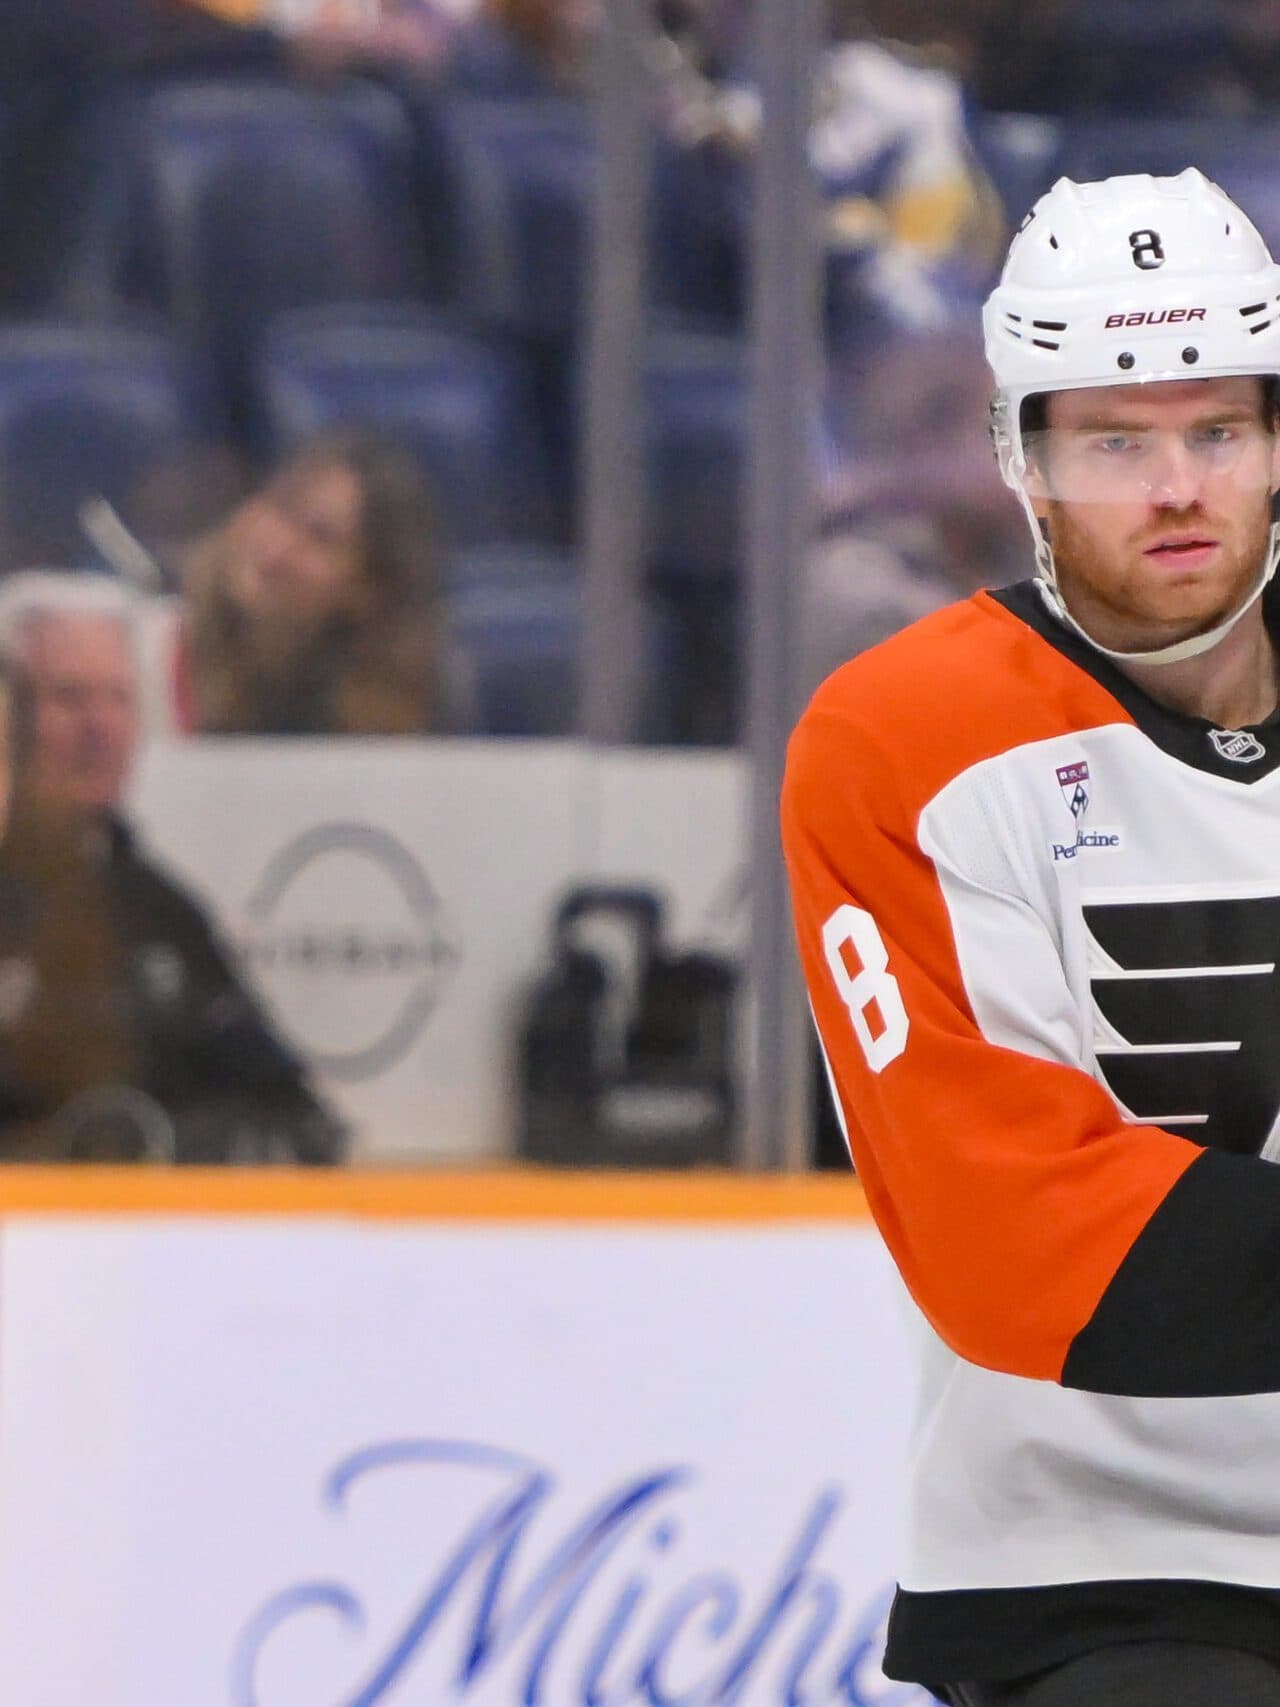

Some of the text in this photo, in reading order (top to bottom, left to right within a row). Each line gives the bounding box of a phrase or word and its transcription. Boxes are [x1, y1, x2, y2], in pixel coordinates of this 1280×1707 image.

[1128, 228, 1166, 270] 8
[822, 903, 910, 1074] 8
[230, 1437, 935, 1707] Miche
